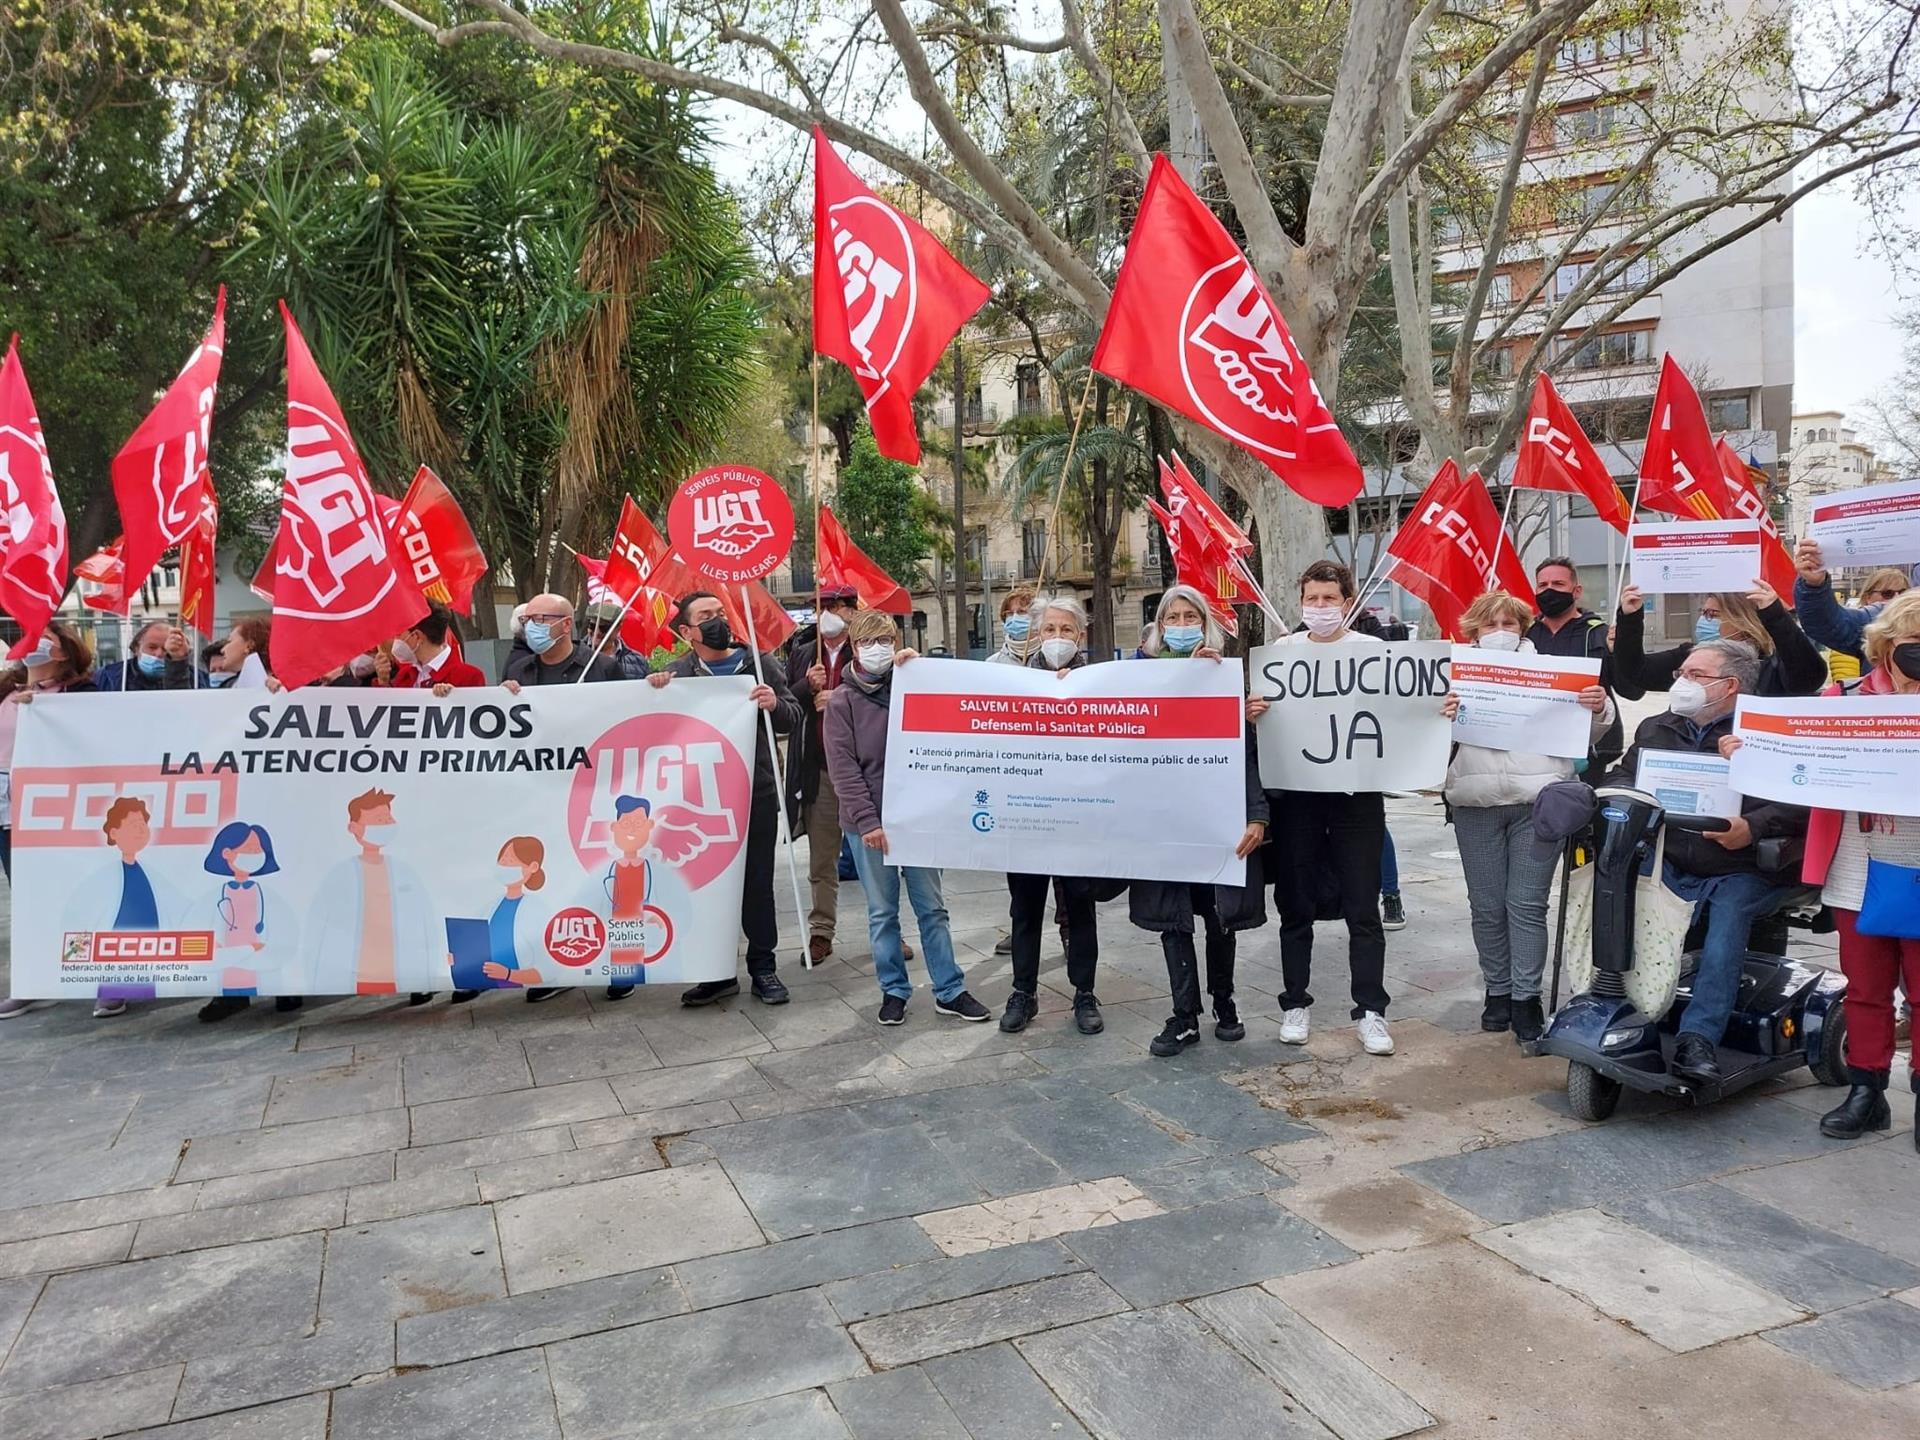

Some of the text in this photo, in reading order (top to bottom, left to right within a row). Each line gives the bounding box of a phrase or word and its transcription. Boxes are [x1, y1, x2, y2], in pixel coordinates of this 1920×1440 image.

[685, 470, 762, 498] SERVEIS PÚBLICS
[286, 424, 388, 578] UGT
[694, 489, 764, 534] UGT
[700, 553, 778, 581] ILLES BALEARS
[960, 700, 1008, 712] SALVEM
[1081, 701, 1150, 715] PRIMÀRIA
[245, 703, 533, 739] SALVEMOS
[971, 718, 1146, 734] Defensem la Sanitat Pública
[1787, 718, 1824, 726] SALVEM
[1877, 716, 1920, 726] PRIMÀRI
[1302, 710, 1383, 764] JA
[1795, 729, 1840, 737] Defensem
[161, 744, 593, 775] LA ATENCIÓN PRIMARIA
[954, 749, 994, 759] primària
[1001, 752, 1063, 762] comunitària,
[1066, 752, 1088, 762] base
[1091, 753, 1106, 763] del
[1109, 754, 1148, 764] sistema
[1152, 754, 1184, 766] públic
[1186, 755, 1200, 764] de
[1202, 755, 1228, 764] salut
[914, 762, 929, 770] Per
[944, 762, 1000, 774] finançament
[1003, 766, 1043, 776] adequat
[590, 741, 726, 818] UGT
[553, 916, 598, 942] UGT
[608, 918, 644, 929] Serveis
[608, 930, 645, 942] Públics
[98, 936, 176, 956] CCOO
[104, 964, 116, 972] de
[118, 963, 148, 972] sanitat
[155, 963, 189, 972] sectors
[602, 965, 634, 976] Salut
[60, 974, 208, 984] sociosanitaris de les Illes Balears
